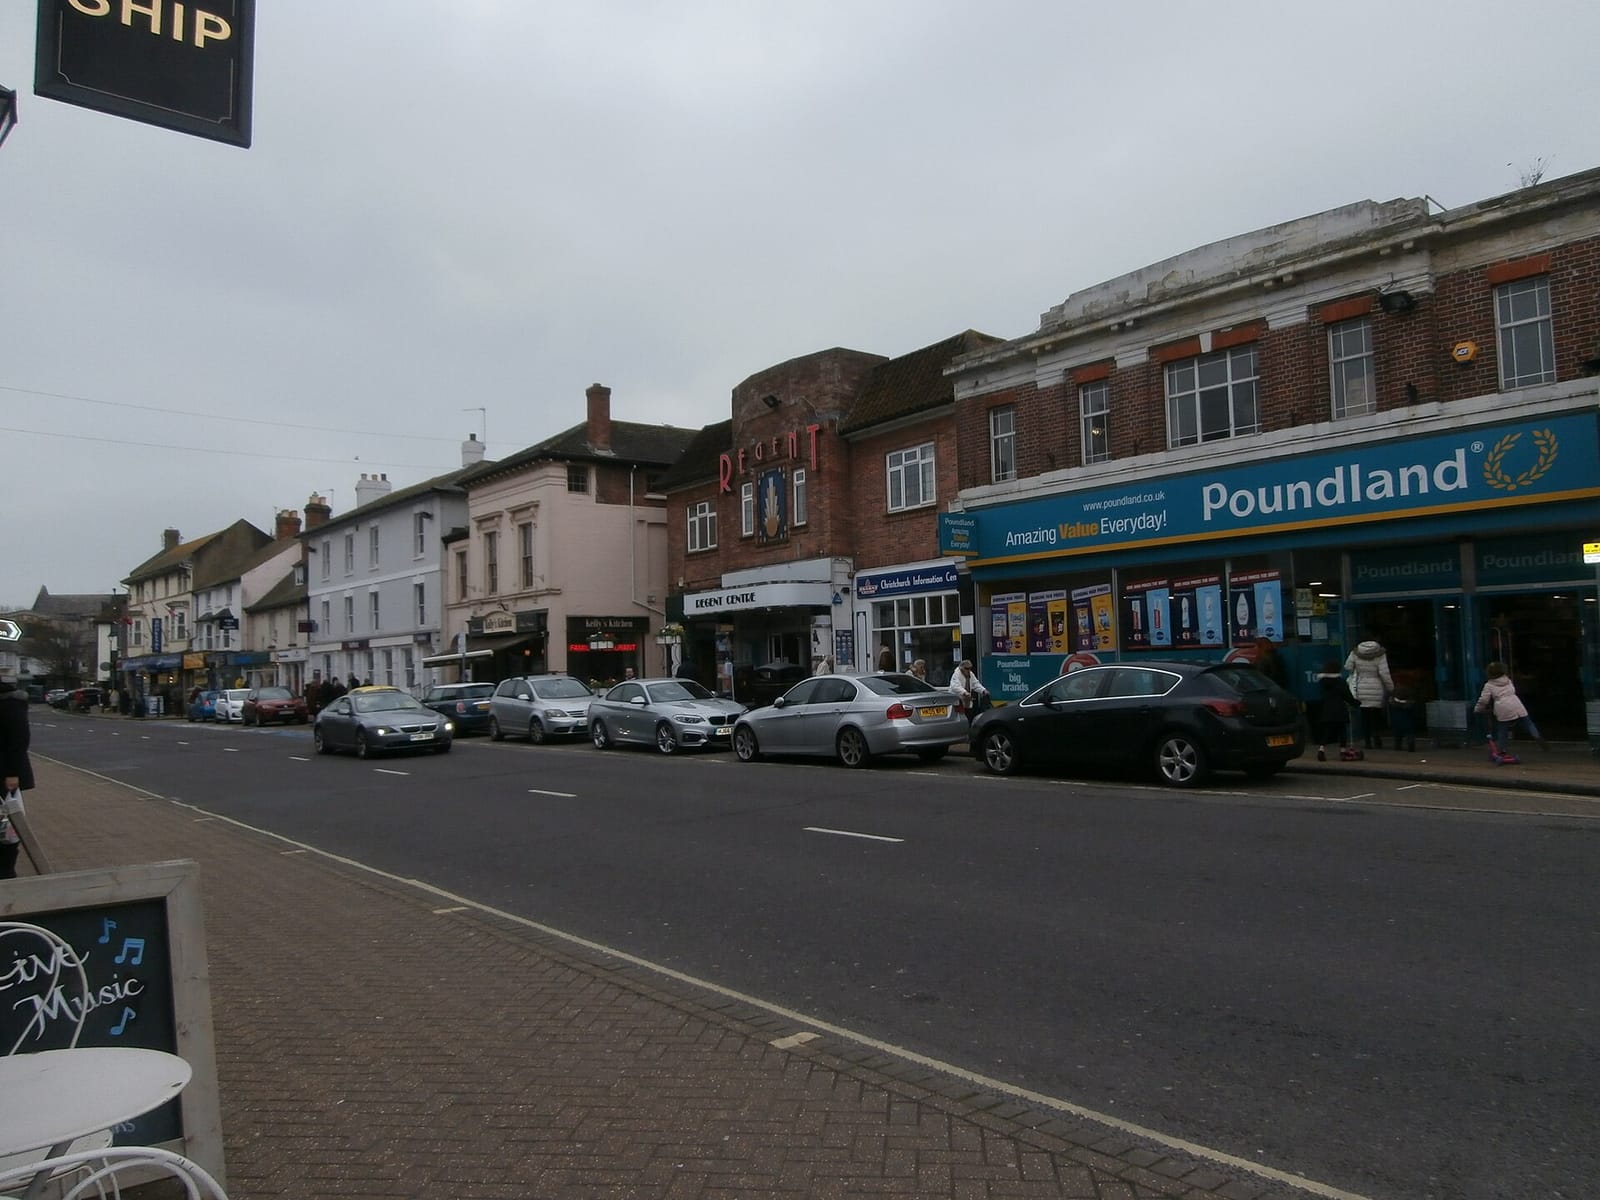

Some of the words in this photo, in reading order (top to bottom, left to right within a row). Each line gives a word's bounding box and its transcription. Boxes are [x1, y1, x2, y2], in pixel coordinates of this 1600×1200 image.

[719, 423, 820, 492] REGENT
[1202, 448, 1468, 521] Poundland
[1083, 491, 1165, 512] www.poundland.co.uk
[944, 518, 975, 527] Poundland
[1005, 527, 1056, 547] Amazing
[1058, 521, 1099, 539] Value
[1100, 510, 1167, 535] Everyday!
[1357, 558, 1454, 579] Poundland
[1482, 550, 1583, 569] Poundlan
[880, 576, 911, 590] Christchurch
[913, 575, 944, 586] Information
[695, 595, 723, 609] REGENT
[726, 592, 756, 605] CENTRE
[585, 618, 608, 630] Kelly's
[609, 618, 633, 628] Kitchen
[997, 660, 1030, 668] Poundland
[1002, 683, 1029, 692] brands
[1009, 673, 1021, 684] big
[13, 974, 145, 1041] Music
